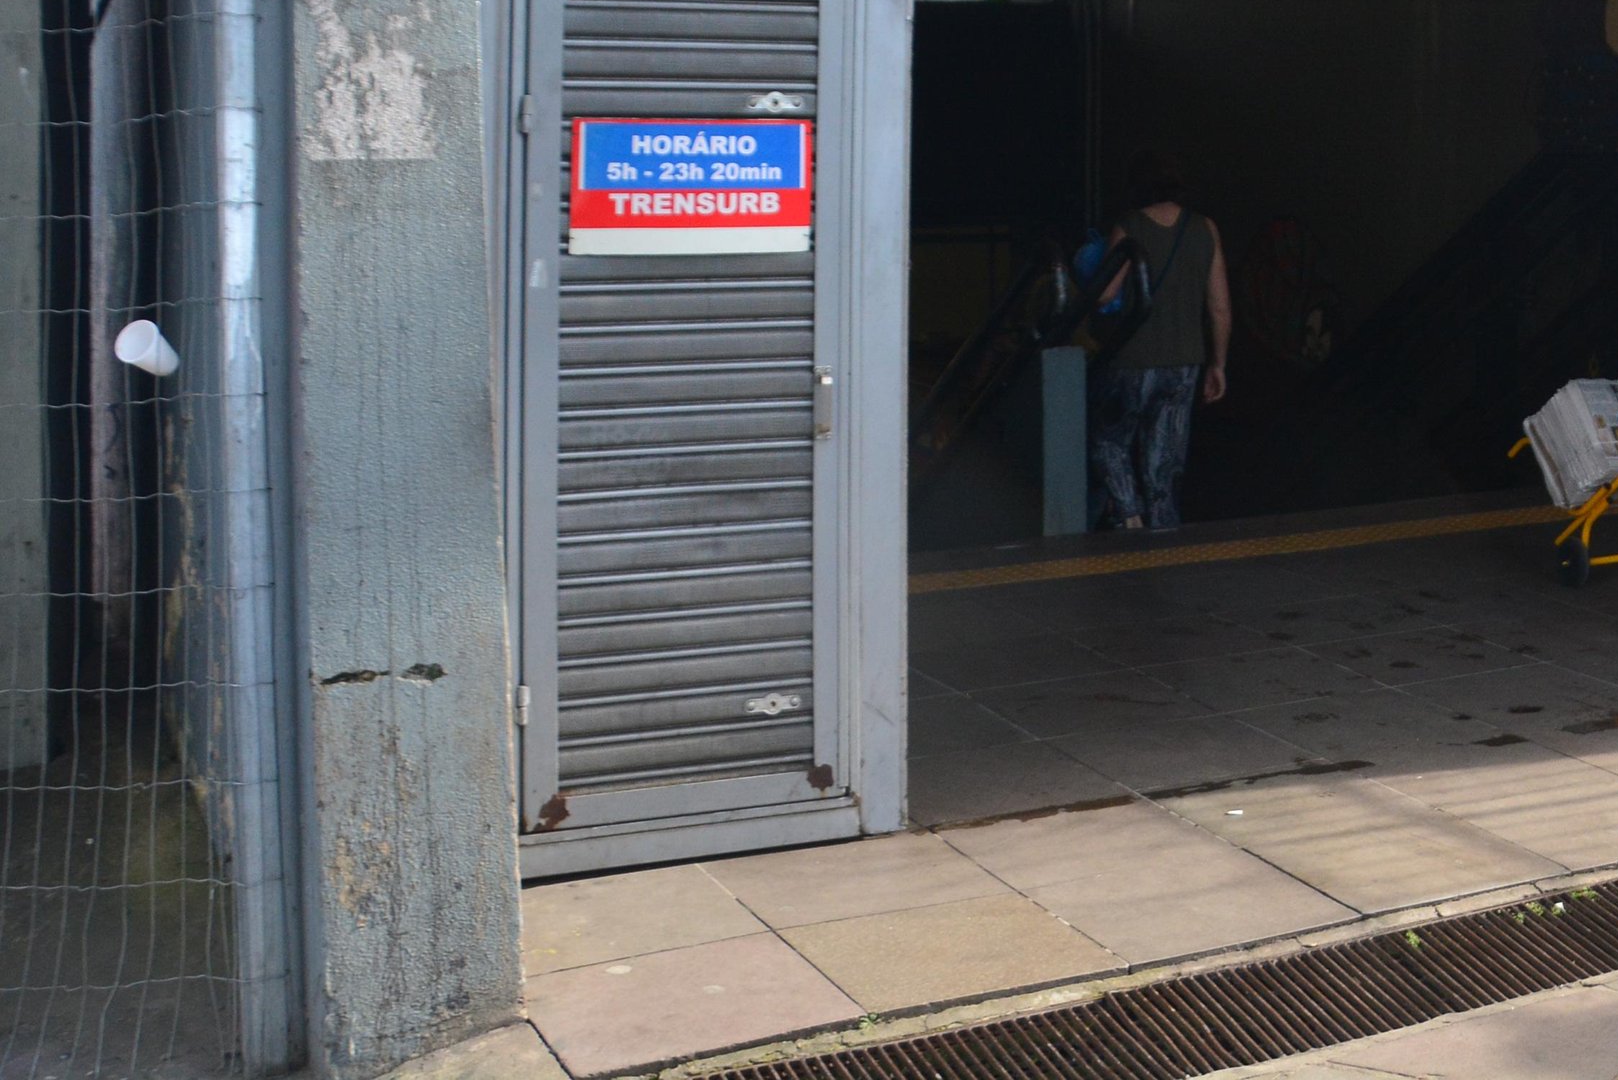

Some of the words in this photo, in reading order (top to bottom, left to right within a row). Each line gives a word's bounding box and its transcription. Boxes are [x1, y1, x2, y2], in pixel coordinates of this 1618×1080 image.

[631, 131, 757, 155] HORÁRIO
[606, 164, 638, 181] 5h
[659, 163, 704, 181] 23h
[710, 163, 783, 181] 20min
[609, 193, 780, 216] TRENSURB
